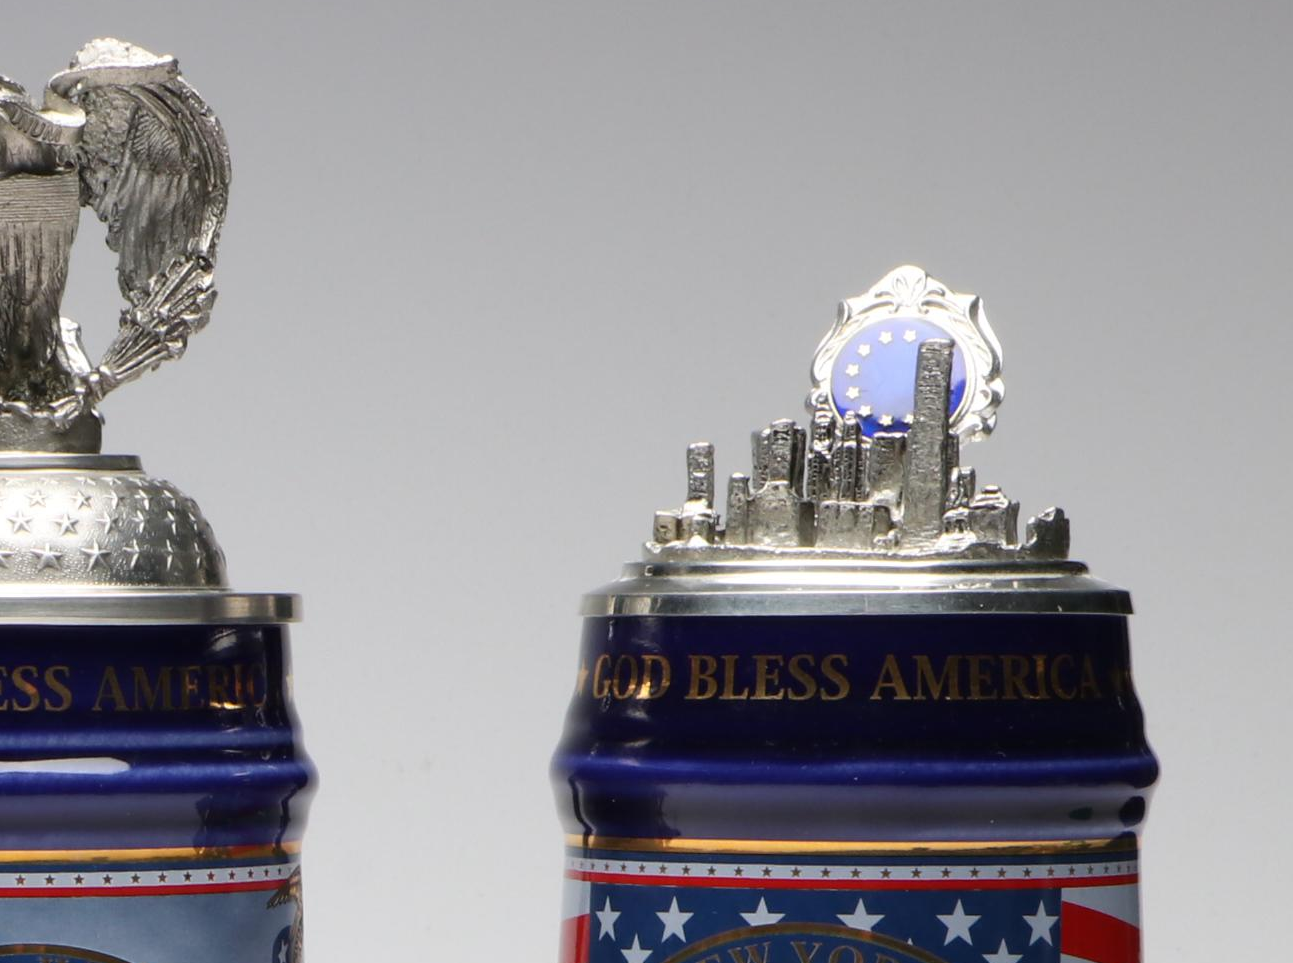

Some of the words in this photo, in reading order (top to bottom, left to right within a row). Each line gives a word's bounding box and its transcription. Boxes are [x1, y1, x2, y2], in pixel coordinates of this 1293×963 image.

[10, 104, 63, 143] UNUM
[91, 664, 270, 713] AMERIC
[592, 653, 672, 700] GOD
[684, 653, 852, 701] BLESS
[869, 652, 1103, 701] AMERICA
